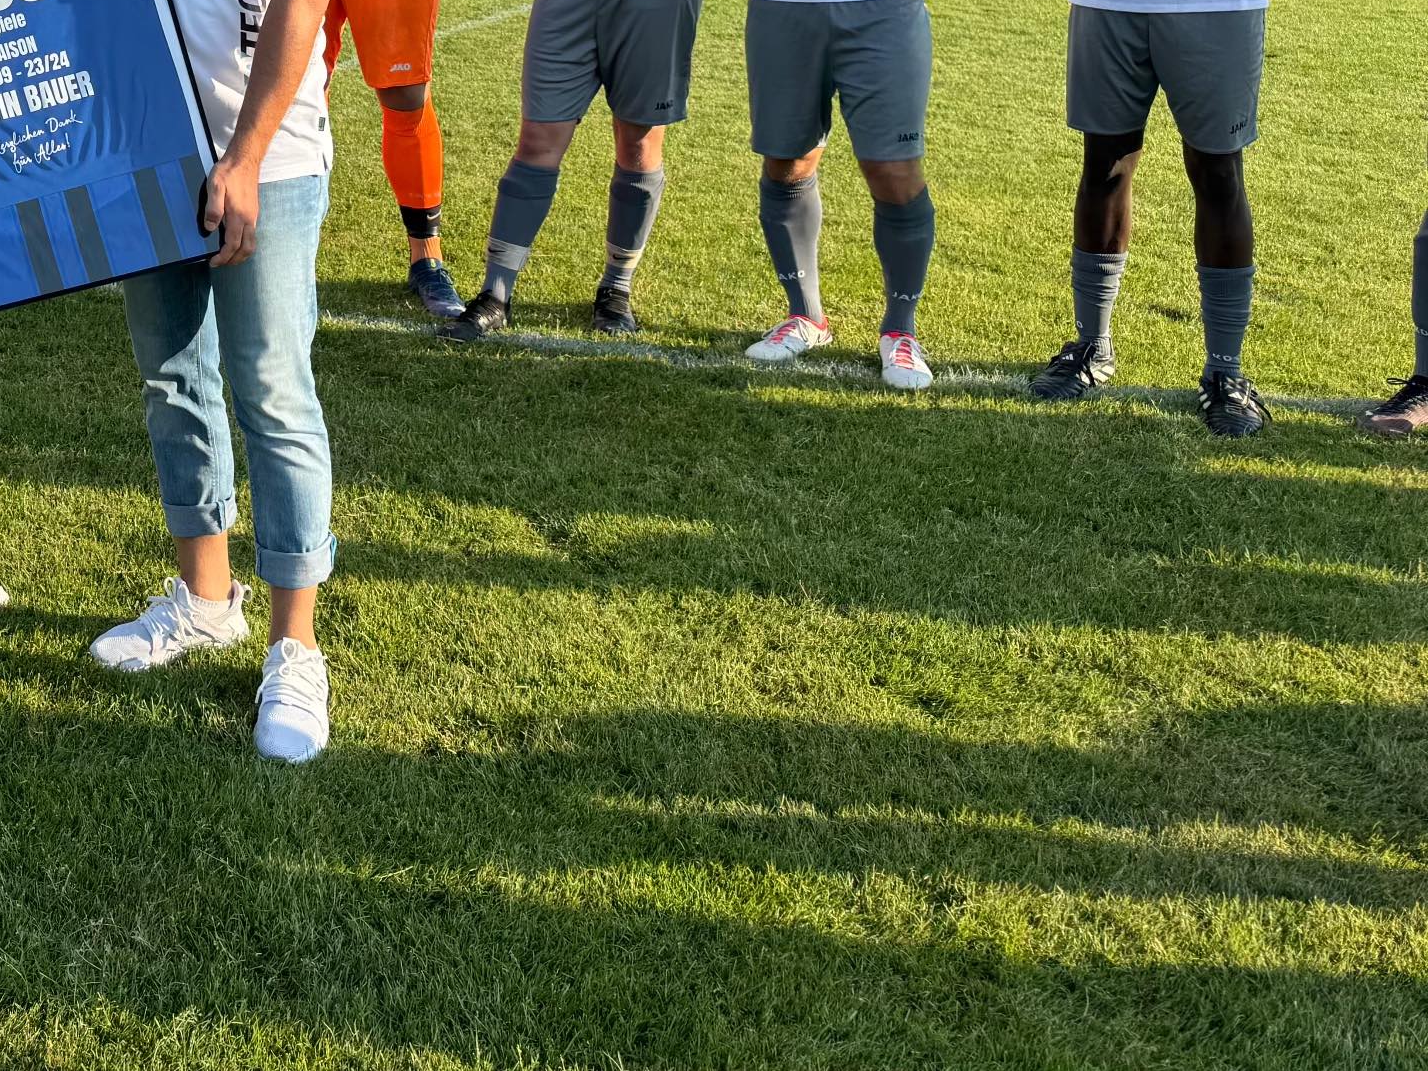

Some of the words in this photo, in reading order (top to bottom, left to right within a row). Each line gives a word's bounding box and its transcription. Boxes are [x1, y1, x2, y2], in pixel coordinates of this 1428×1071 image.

[24, 50, 71, 78] 23/24
[23, 70, 95, 113] BAUER
[45, 109, 84, 133] Dank
[12, 152, 33, 174] für
[778, 270, 806, 281] AKO
